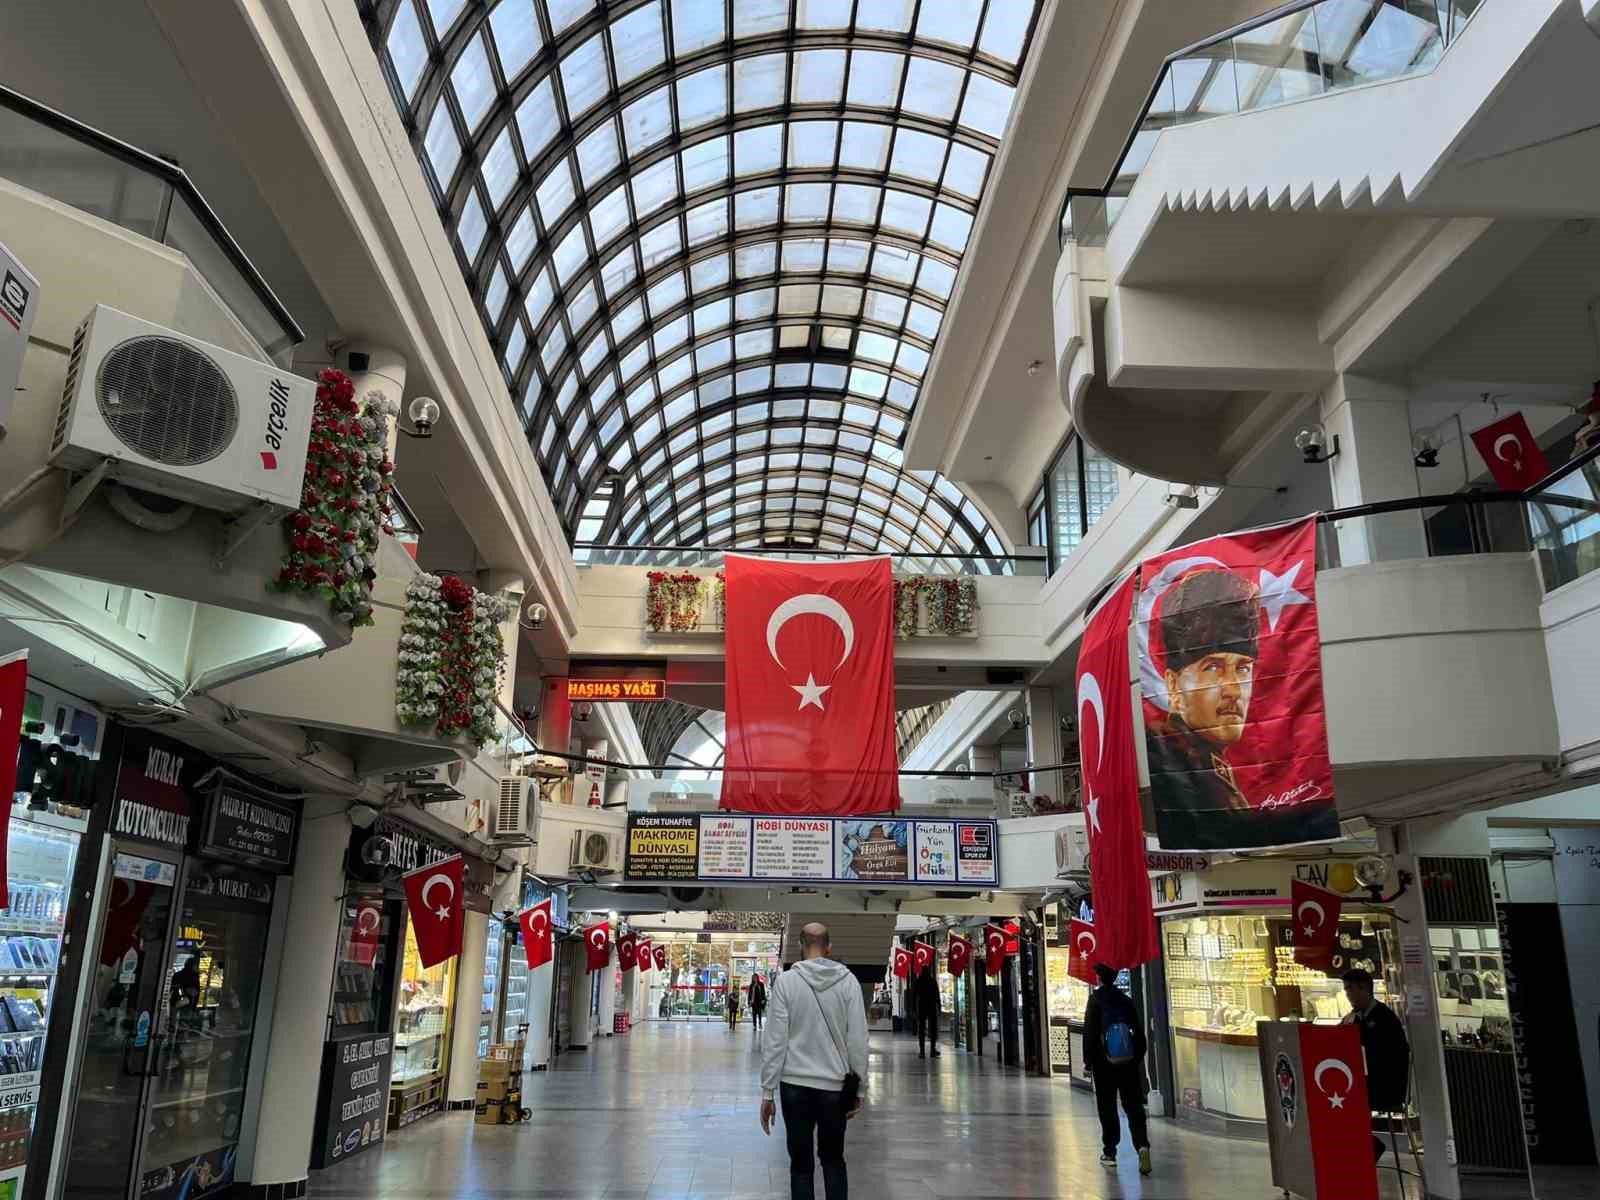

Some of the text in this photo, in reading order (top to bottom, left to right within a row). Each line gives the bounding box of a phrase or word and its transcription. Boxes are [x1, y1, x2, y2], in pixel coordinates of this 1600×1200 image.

[265, 378, 291, 451] arçelik
[568, 680, 657, 698] HAŞHAŞ YAĞI
[144, 746, 185, 786] MURAT
[115, 798, 191, 846] KUYUMCULUK
[636, 816, 660, 828] KÖŞEM
[756, 820, 829, 832] HOBİ DÜNYASI
[632, 830, 695, 841] MAKROME
[637, 841, 689, 854] DÜNYASI
[4, 1088, 32, 1107] SERVİS
